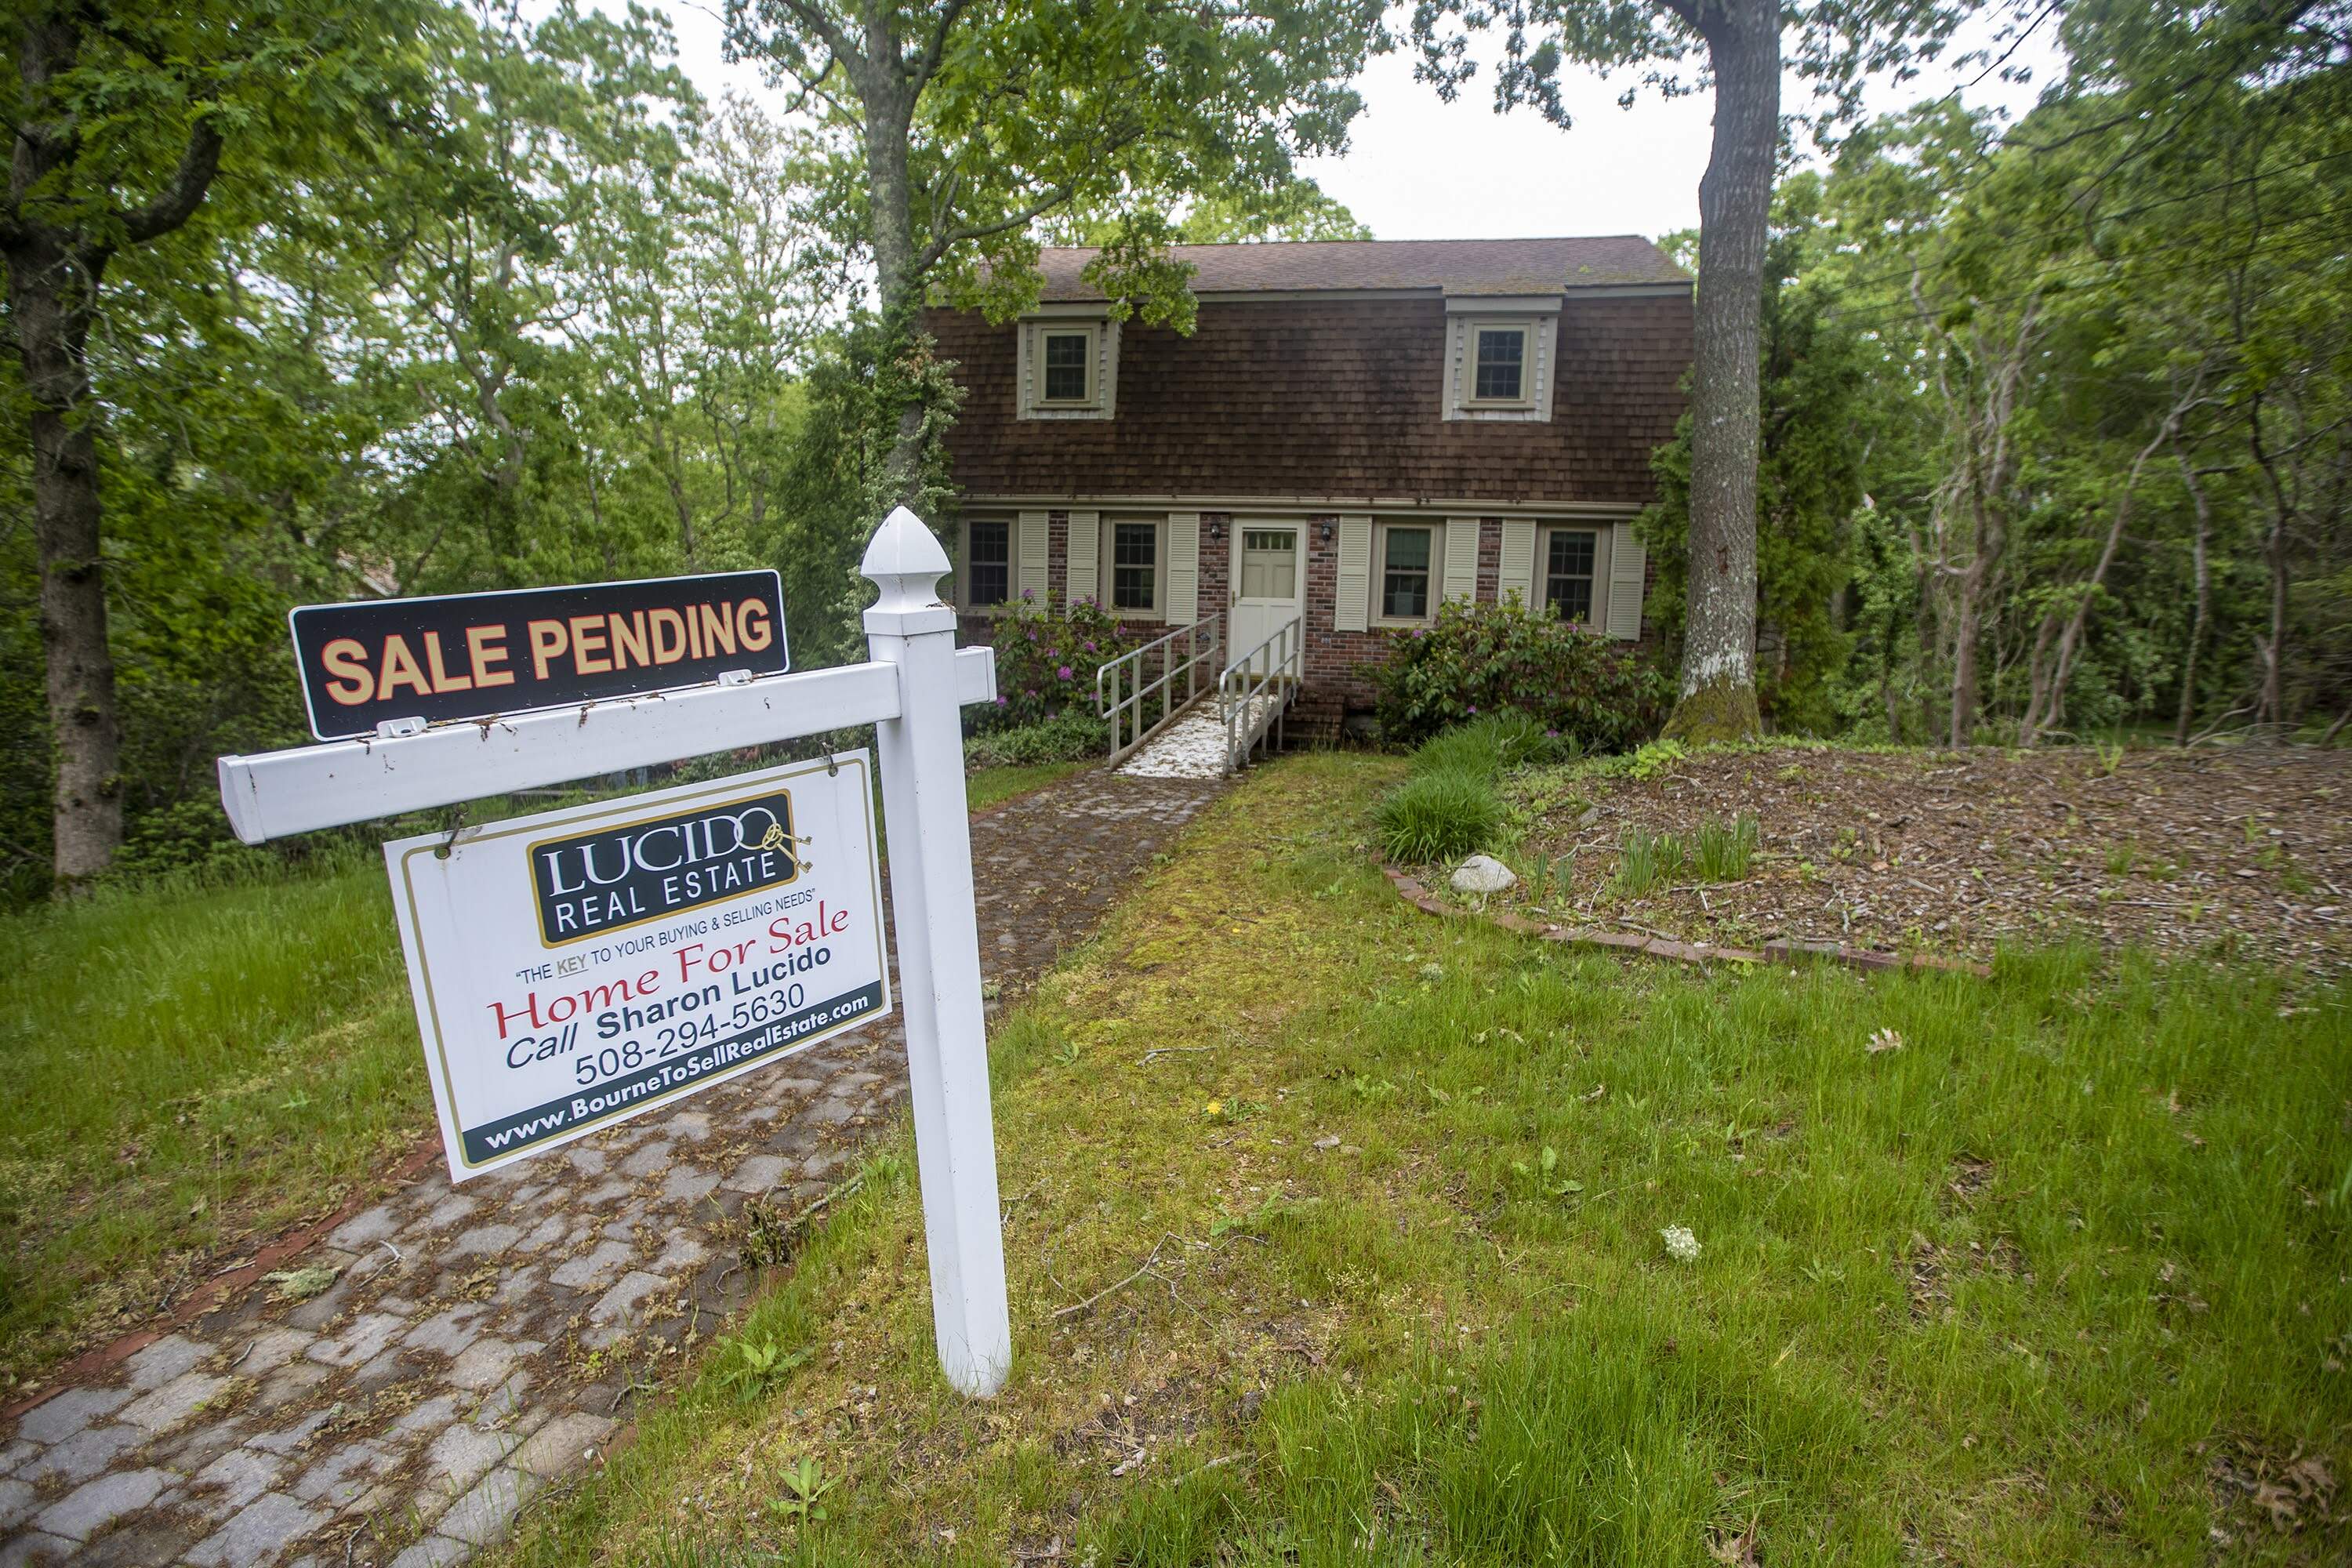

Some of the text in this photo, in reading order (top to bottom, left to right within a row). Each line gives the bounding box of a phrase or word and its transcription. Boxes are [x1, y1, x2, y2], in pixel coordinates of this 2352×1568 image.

[321, 597, 772, 706] SALE PENDING
[543, 807, 777, 897] LUCIDO
[555, 851, 776, 933] REAL ESTATE
[486, 900, 850, 1040] Home For Sale
[557, 953, 589, 978] KEY
[591, 948, 612, 964] TO
[615, 935, 656, 957] YOUR
[659, 920, 707, 946] BUYING
[712, 917, 720, 931] &
[724, 902, 772, 927] SELLING
[506, 946, 831, 1069] Call Sharon Lucido
[575, 982, 805, 1086] 508-294-5630
[485, 993, 869, 1149] www.BourneToSellRealEstate.com
